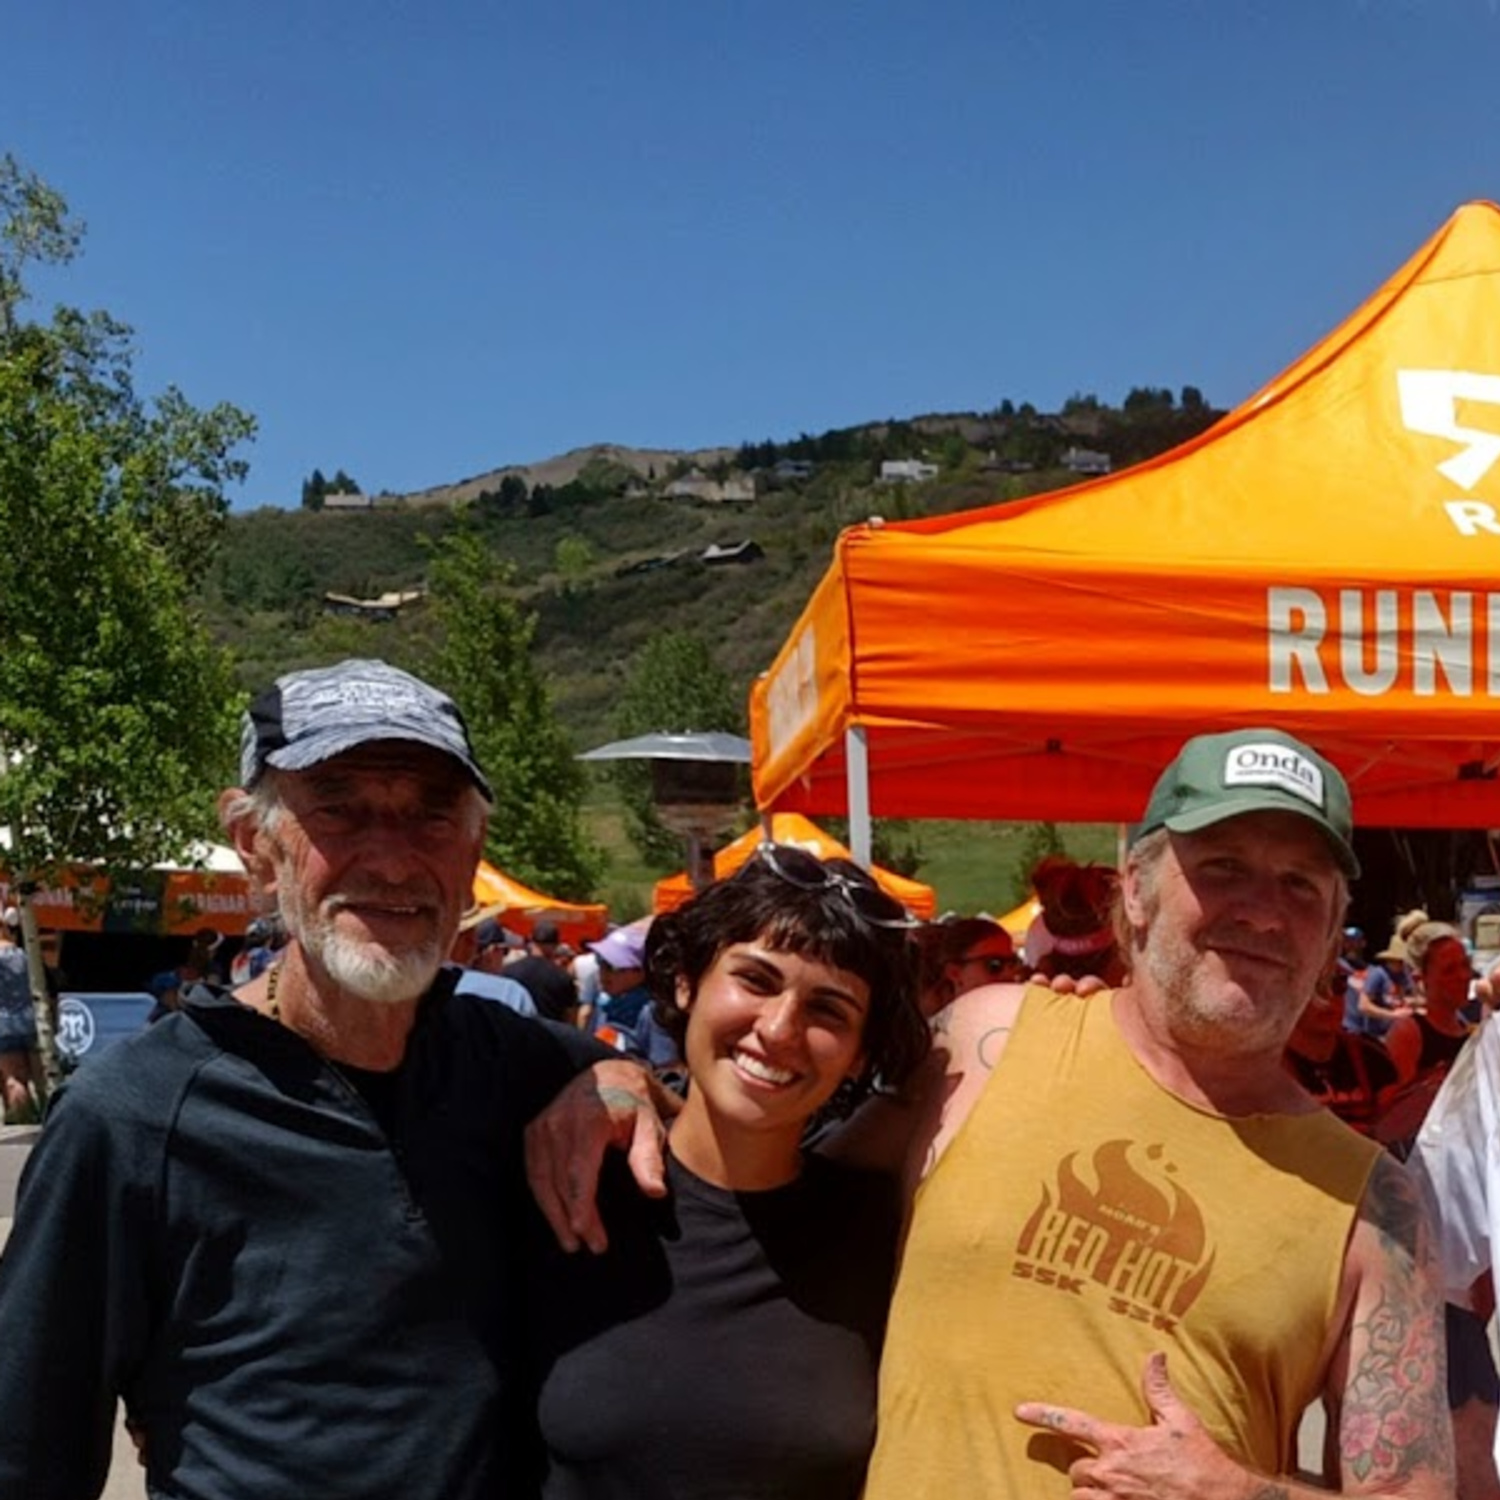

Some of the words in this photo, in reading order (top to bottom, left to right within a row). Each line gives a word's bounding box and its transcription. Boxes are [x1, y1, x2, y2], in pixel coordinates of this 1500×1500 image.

[1236, 749, 1314, 783] Onda
[1029, 1209, 1110, 1279] RED
[1107, 1239, 1196, 1317] HOT
